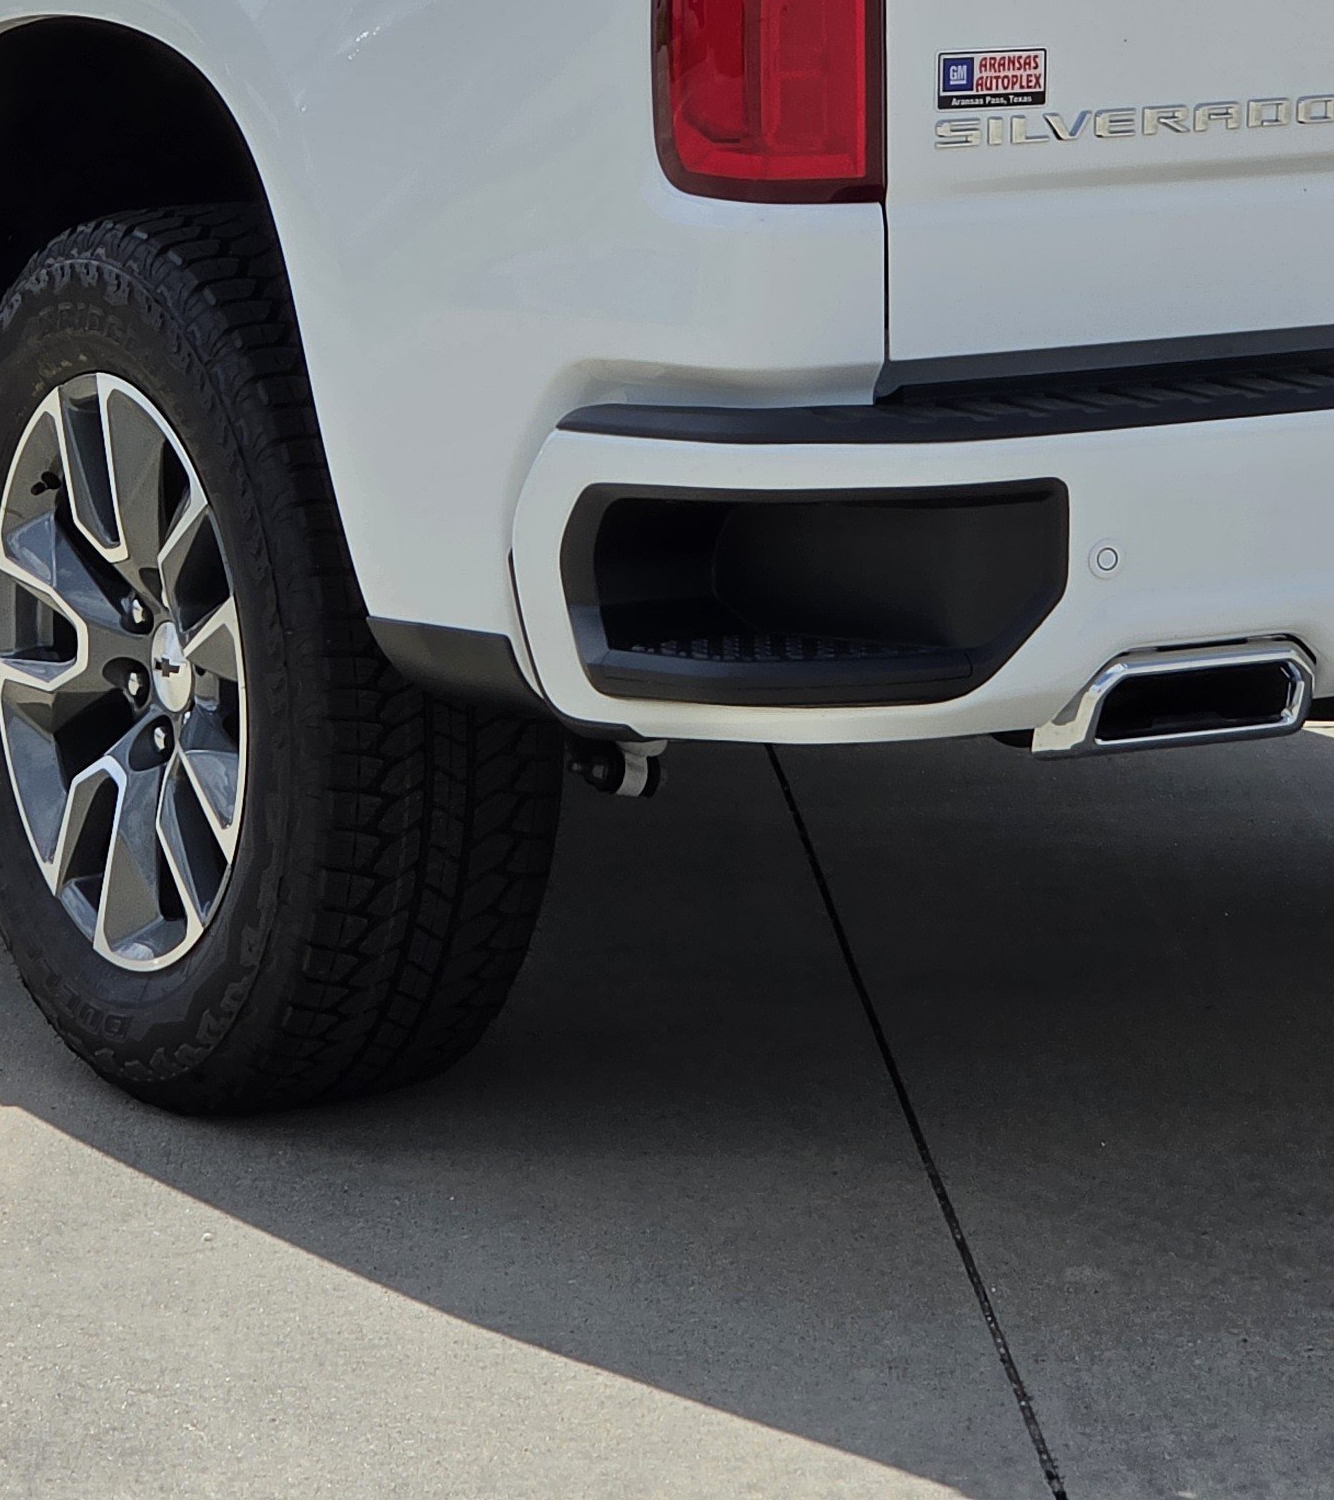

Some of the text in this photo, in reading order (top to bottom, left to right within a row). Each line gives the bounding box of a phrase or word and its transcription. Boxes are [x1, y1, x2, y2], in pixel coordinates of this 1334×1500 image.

[949, 65, 967, 81] GM
[979, 55, 1039, 74] ARANSAS
[975, 73, 1042, 92] AUTOPLEX
[951, 96, 984, 106] Aransas
[1008, 94, 1032, 104] Texas
